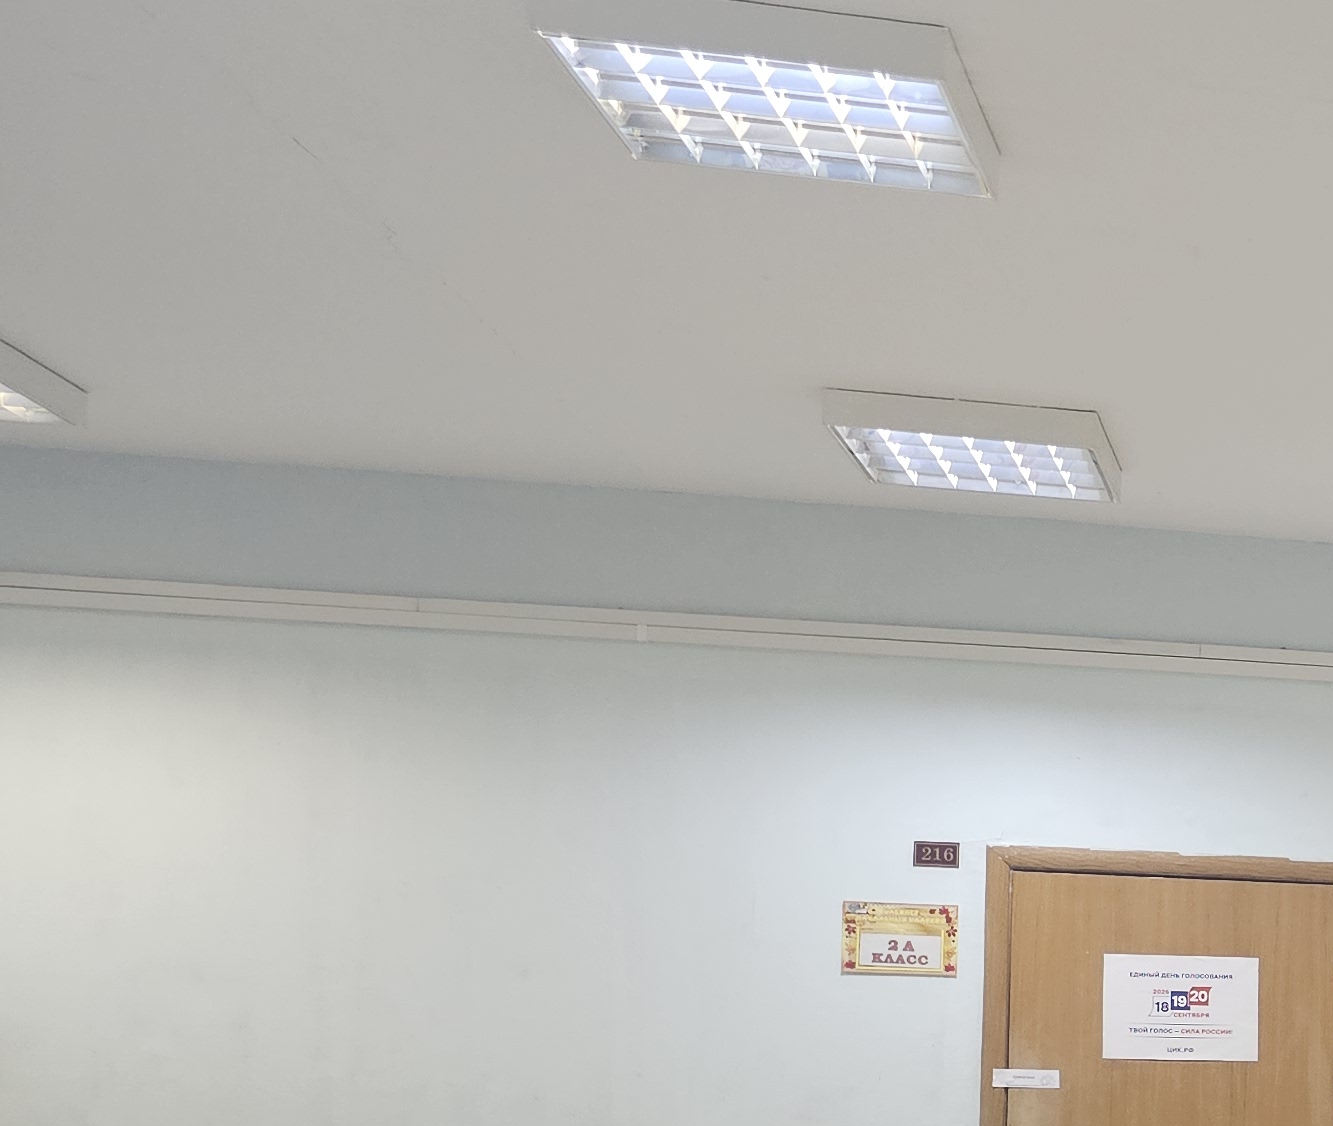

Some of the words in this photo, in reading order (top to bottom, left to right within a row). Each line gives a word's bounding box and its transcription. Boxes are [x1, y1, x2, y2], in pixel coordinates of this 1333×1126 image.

[921, 846, 954, 861] 216
[888, 940, 898, 951] 2
[903, 941, 915, 952] А
[871, 953, 929, 965] КЛАСС
[1129, 971, 1160, 979] ЕДИНЫЙ
[1154, 1001, 1170, 1012] 18
[1172, 995, 1187, 1007] 19
[1189, 990, 1208, 1002] 20
